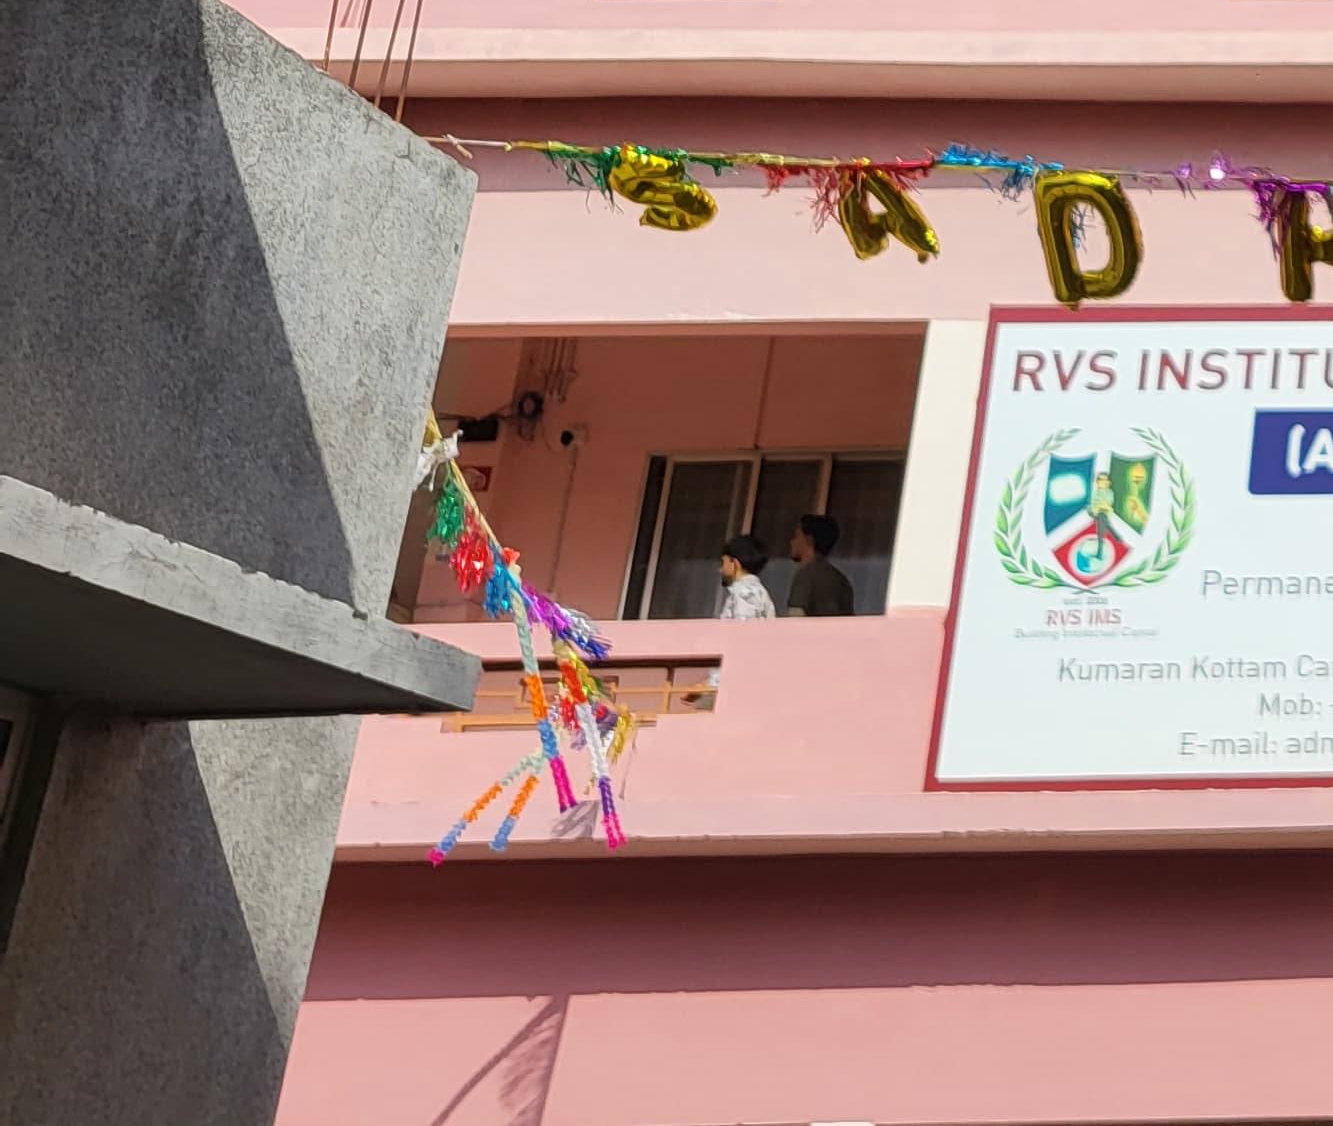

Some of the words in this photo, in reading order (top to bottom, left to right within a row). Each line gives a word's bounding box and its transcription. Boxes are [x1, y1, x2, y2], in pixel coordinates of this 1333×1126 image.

[1012, 349, 1119, 392] RVS
[1046, 609, 1081, 626] RVS
[1087, 608, 1121, 625] IMS
[1059, 658, 1180, 681] Kumaran
[1191, 656, 1286, 679] Kottam
[1259, 693, 1322, 716] Mob:
[1179, 732, 1277, 755] E-mail:
